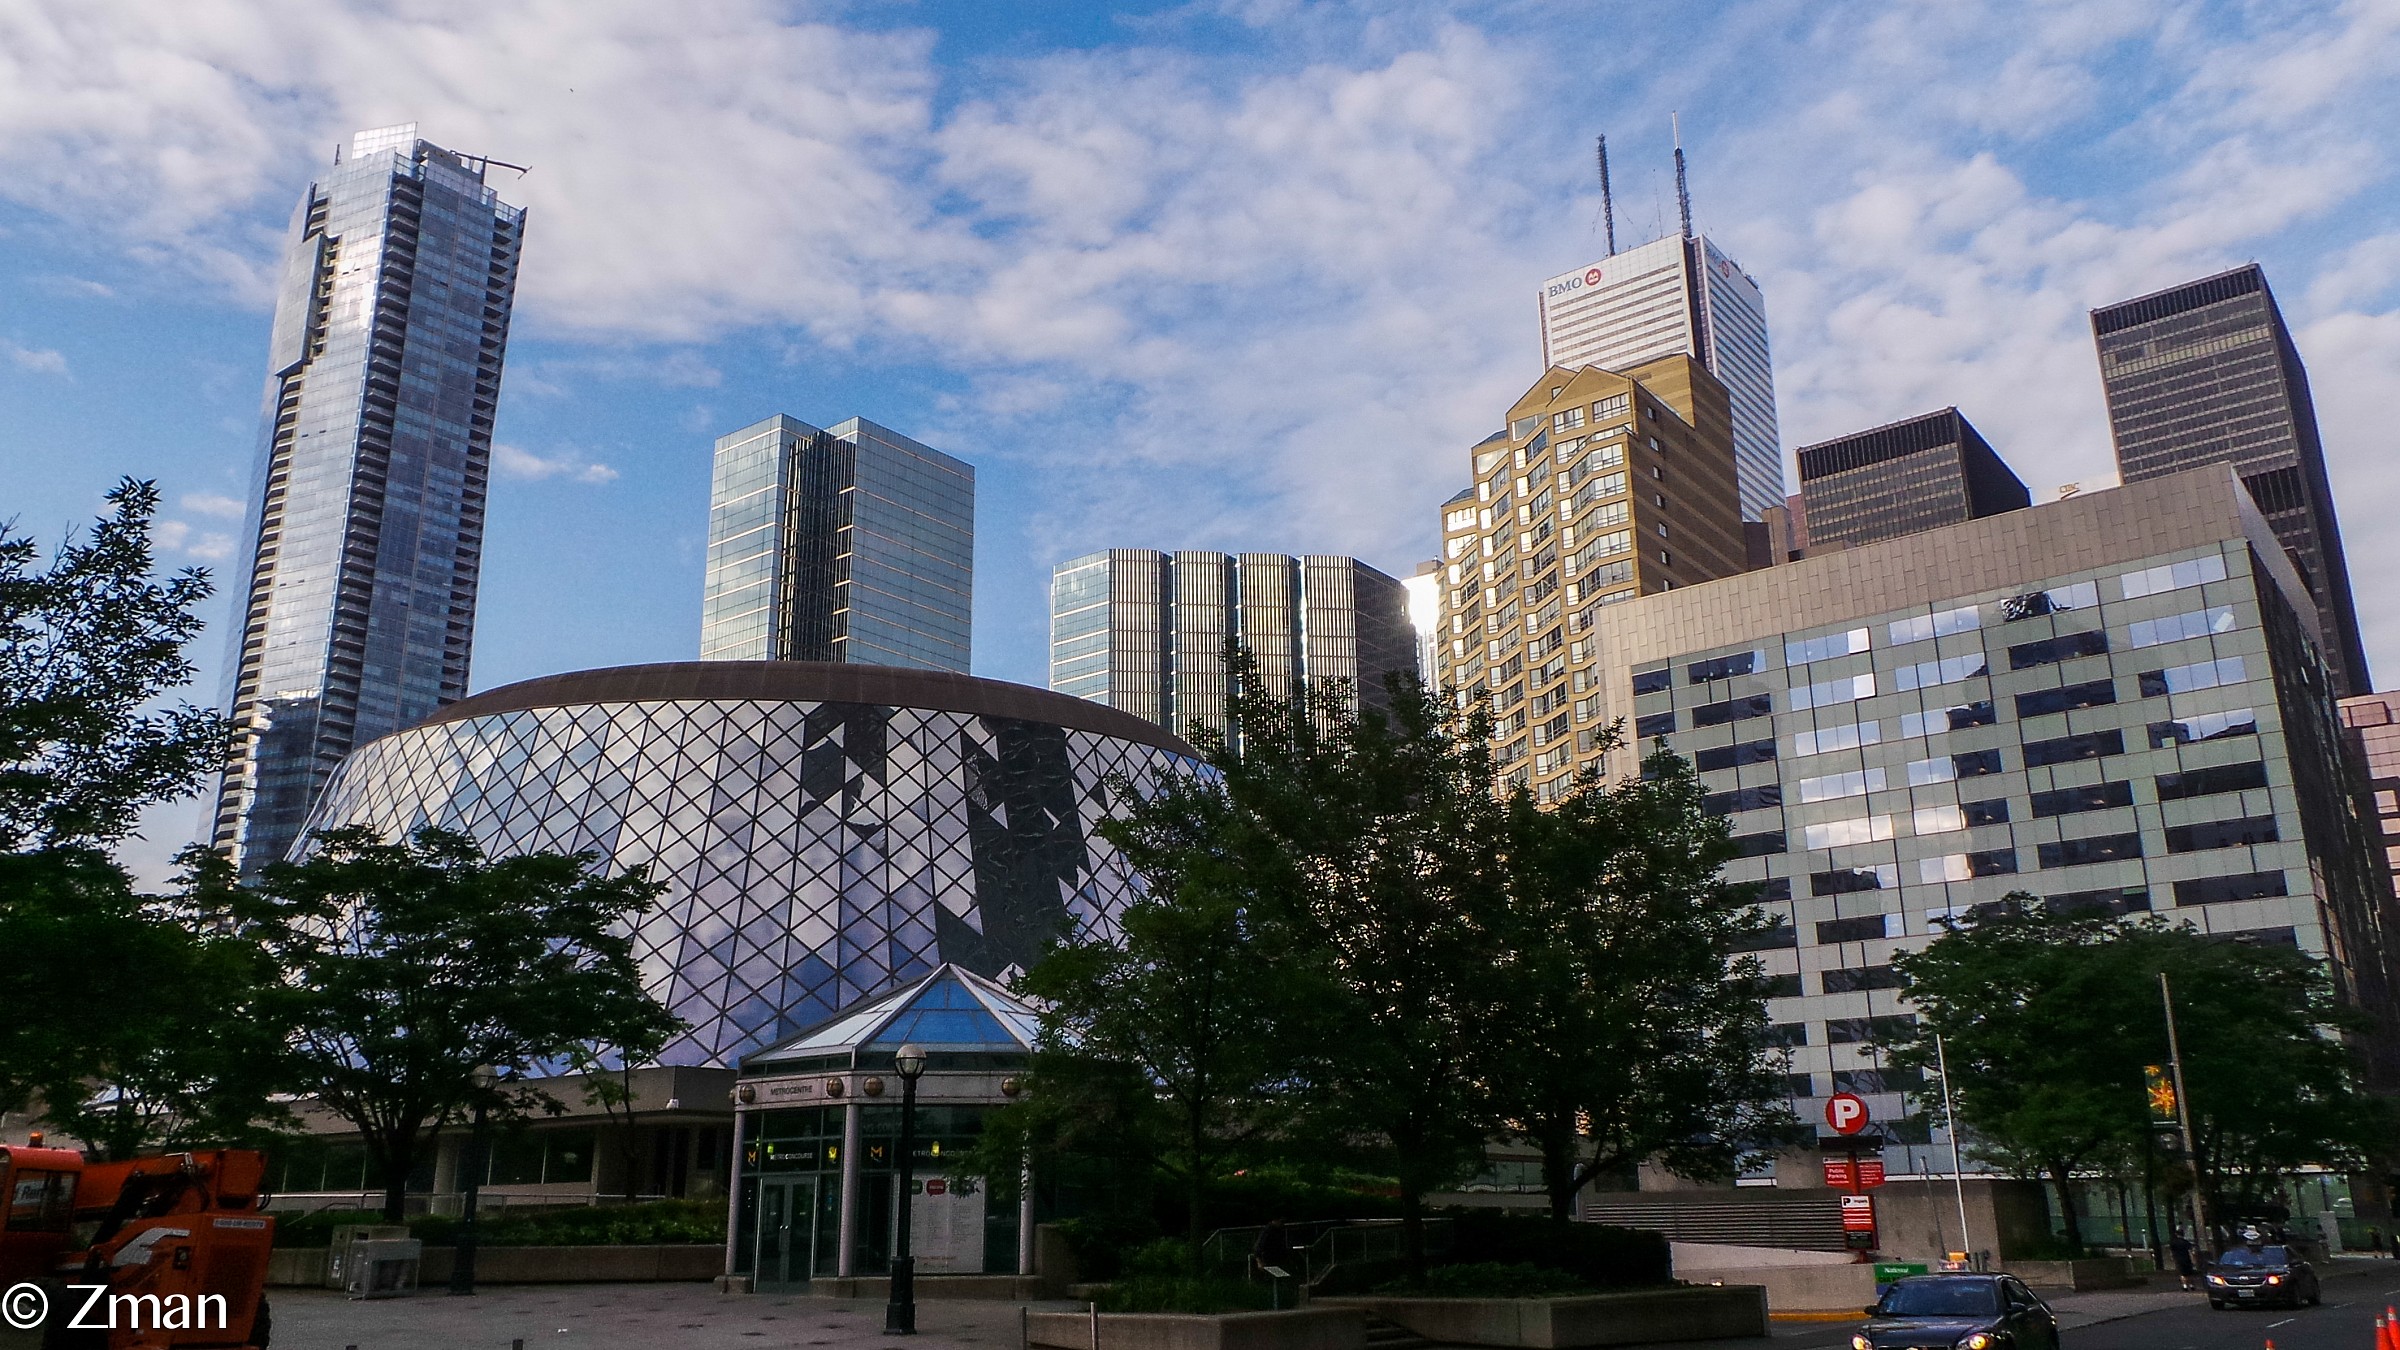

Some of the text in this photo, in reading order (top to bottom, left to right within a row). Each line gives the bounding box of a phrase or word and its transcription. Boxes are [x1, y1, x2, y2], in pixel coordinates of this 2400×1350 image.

[1548, 276, 1583, 298] BMO
[770, 1085, 813, 1096] METROCENTRE
[1833, 1098, 1860, 1128] P
